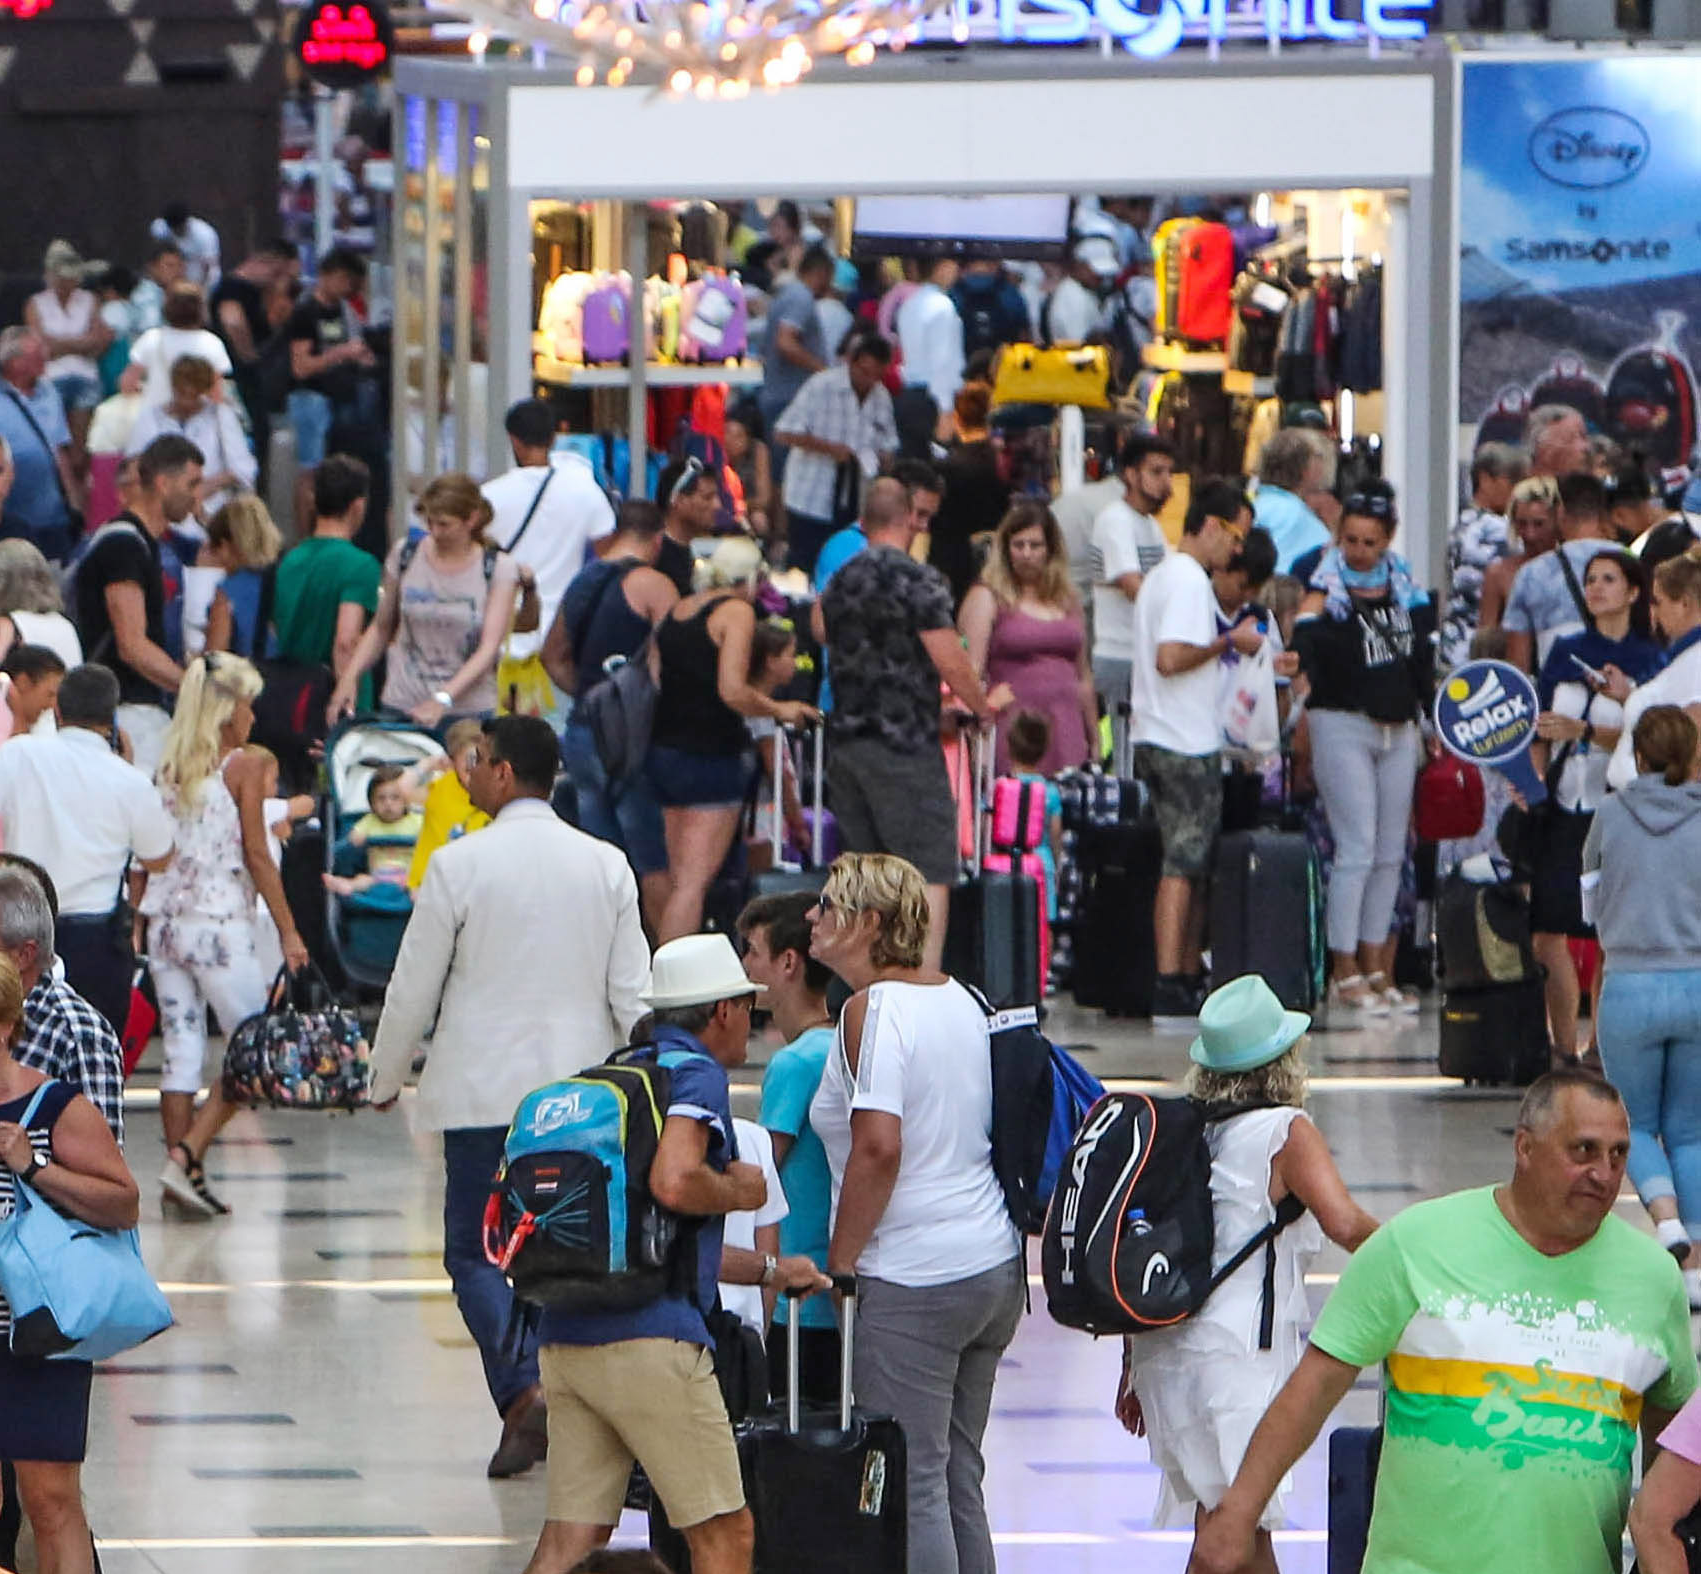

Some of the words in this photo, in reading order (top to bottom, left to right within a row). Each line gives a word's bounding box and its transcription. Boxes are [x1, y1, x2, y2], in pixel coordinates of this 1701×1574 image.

[1544, 128, 1641, 169] Disney
[1505, 237, 1671, 263] Samsonite
[1060, 1101, 1124, 1285] HEAD
